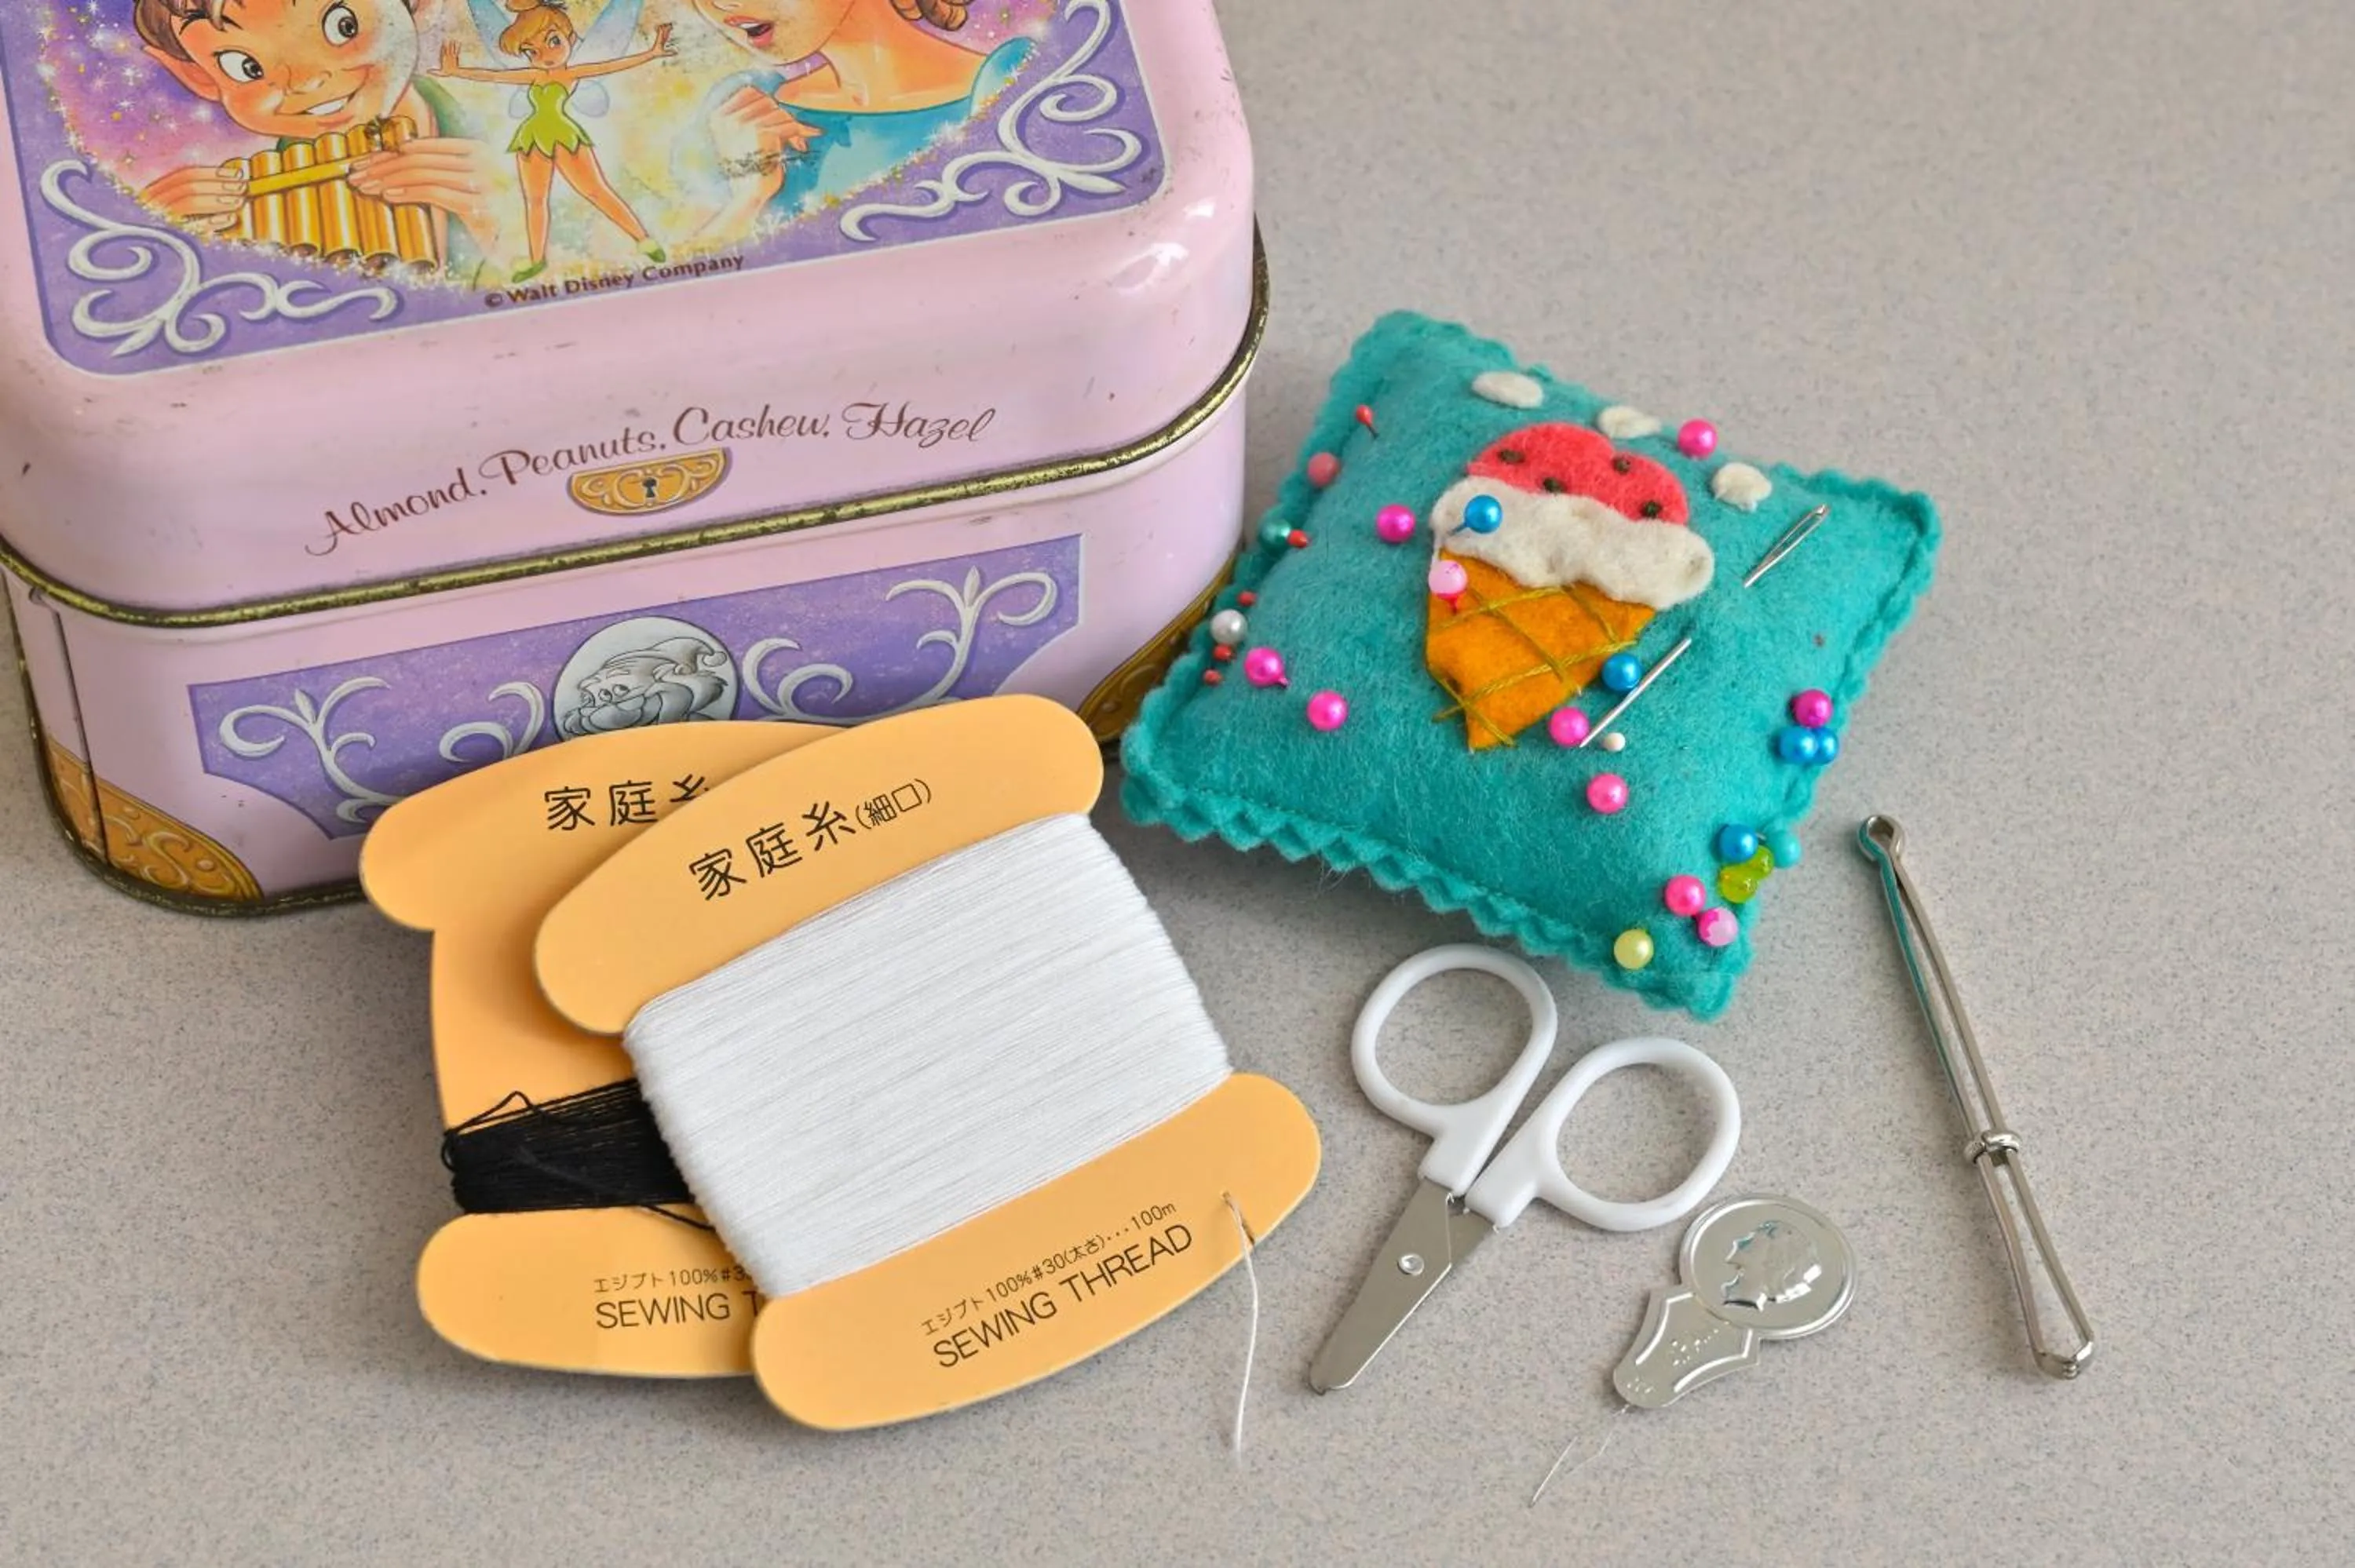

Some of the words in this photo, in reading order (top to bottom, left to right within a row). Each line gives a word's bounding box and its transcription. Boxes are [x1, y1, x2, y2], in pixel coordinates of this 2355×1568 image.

[564, 272, 634, 296] Disney
[642, 256, 745, 282] Company
[841, 401, 996, 448] Hazel
[596, 1293, 730, 1329] SEWING
[933, 1290, 1057, 1368] SEWING
[1058, 1224, 1192, 1303] THREAD
